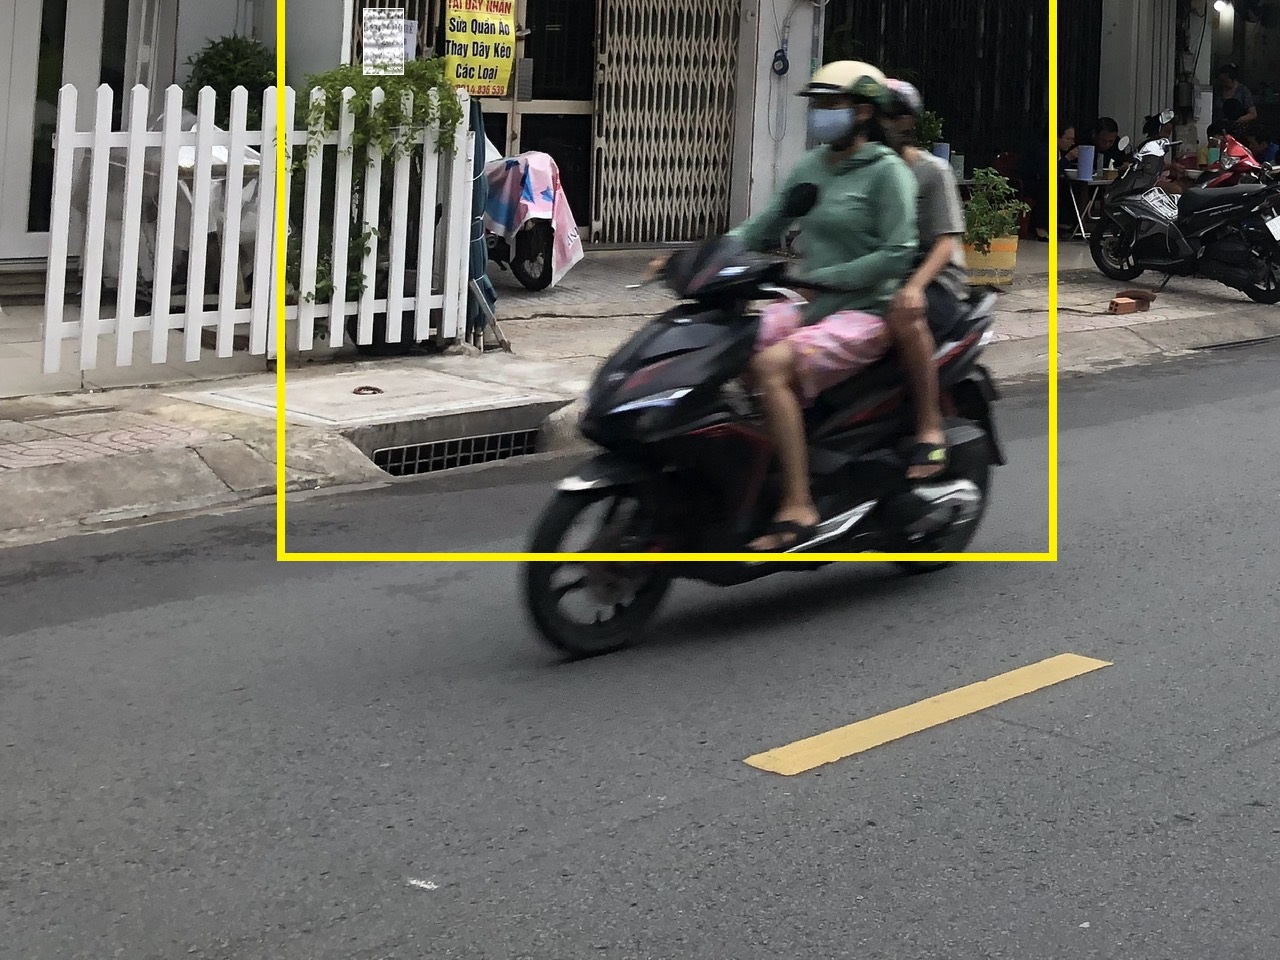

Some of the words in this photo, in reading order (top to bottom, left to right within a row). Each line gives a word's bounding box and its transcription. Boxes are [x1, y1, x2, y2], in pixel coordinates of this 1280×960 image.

[486, 0, 512, 16] NHẬN
[449, 15, 467, 33] Sửa
[471, 18, 496, 35] Quần
[445, 40, 468, 58] Thay
[472, 41, 490, 59] Dây
[494, 42, 511, 58] Kéo
[456, 63, 475, 79] Các
[478, 65, 499, 83] Loại
